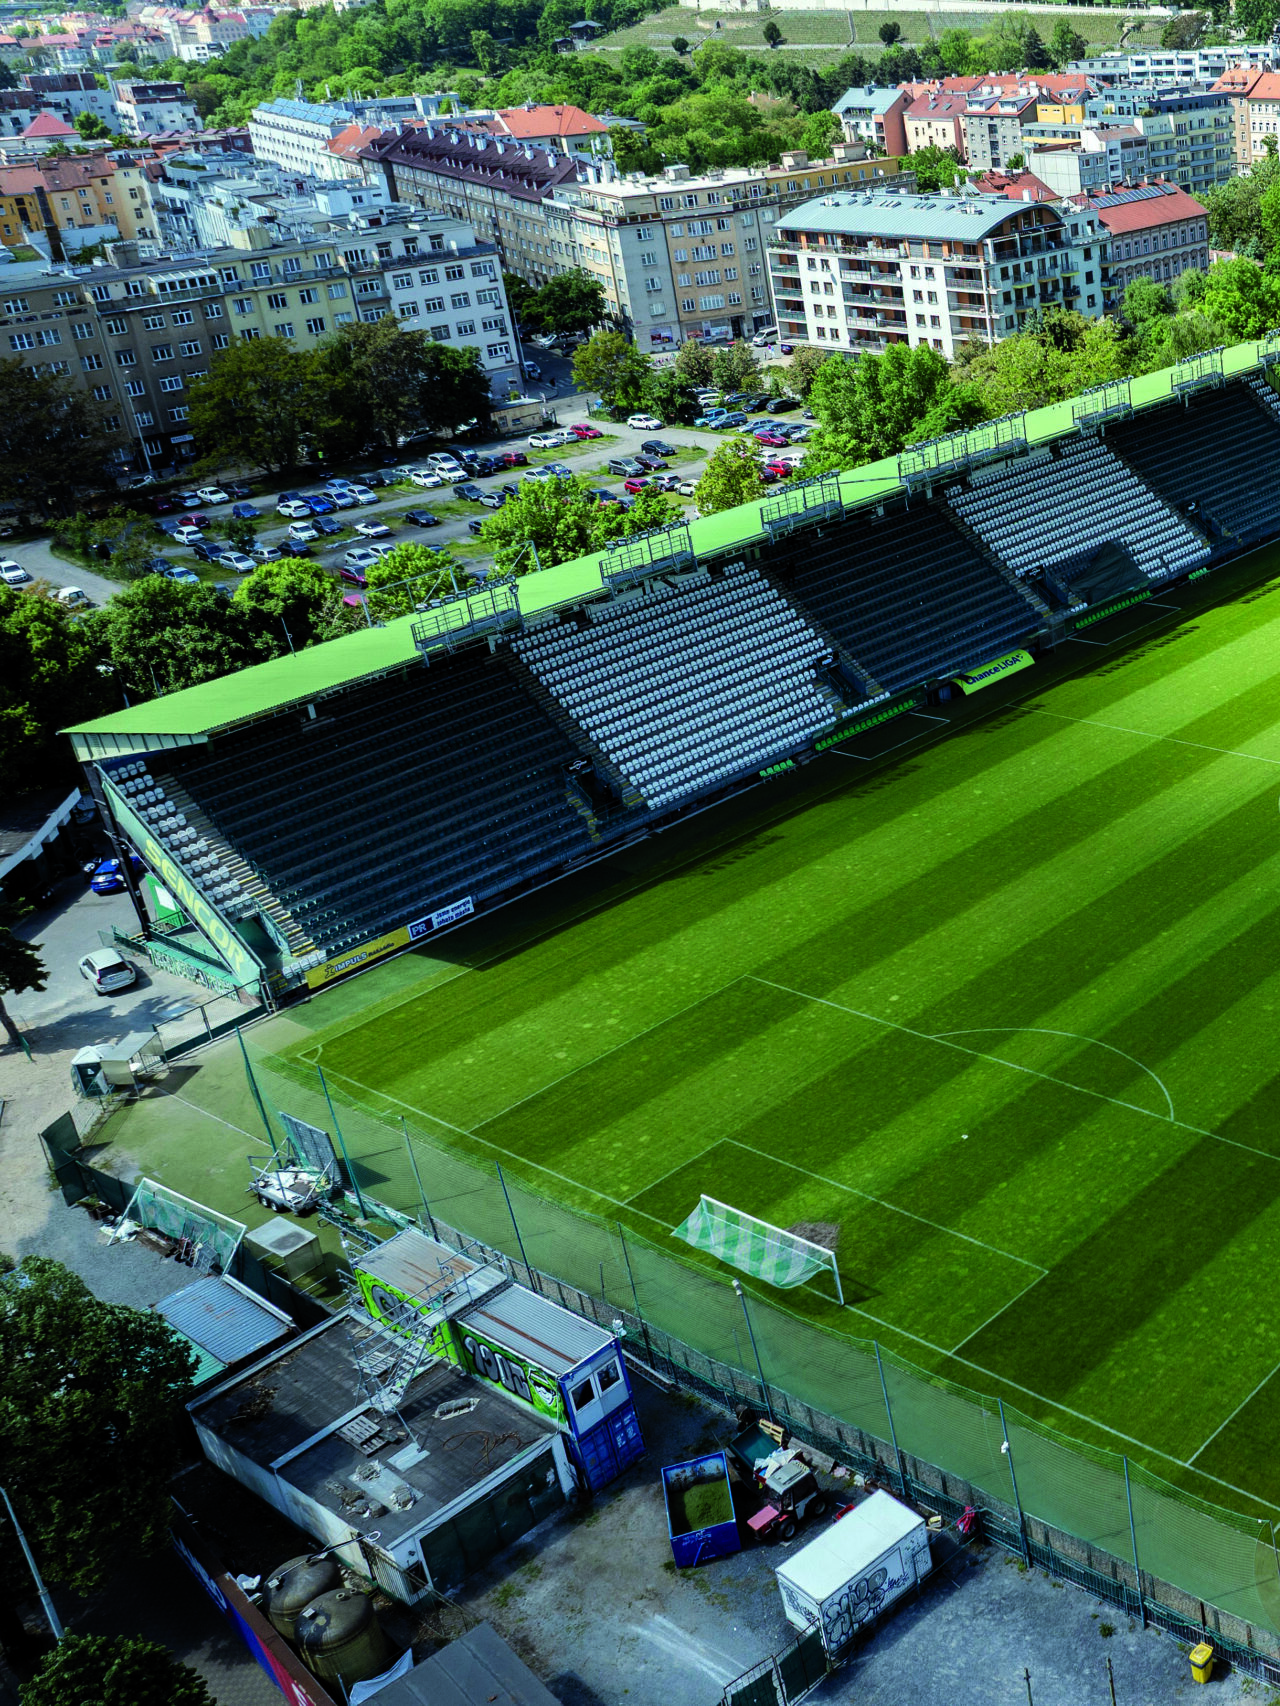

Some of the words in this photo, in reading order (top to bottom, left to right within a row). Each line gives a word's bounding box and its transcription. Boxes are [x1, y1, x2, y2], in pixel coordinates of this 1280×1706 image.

[966, 665, 1000, 685] Chance
[997, 656, 1020, 670] LIGA
[145, 839, 244, 971] SENCOR
[334, 952, 367, 972] IMPULS
